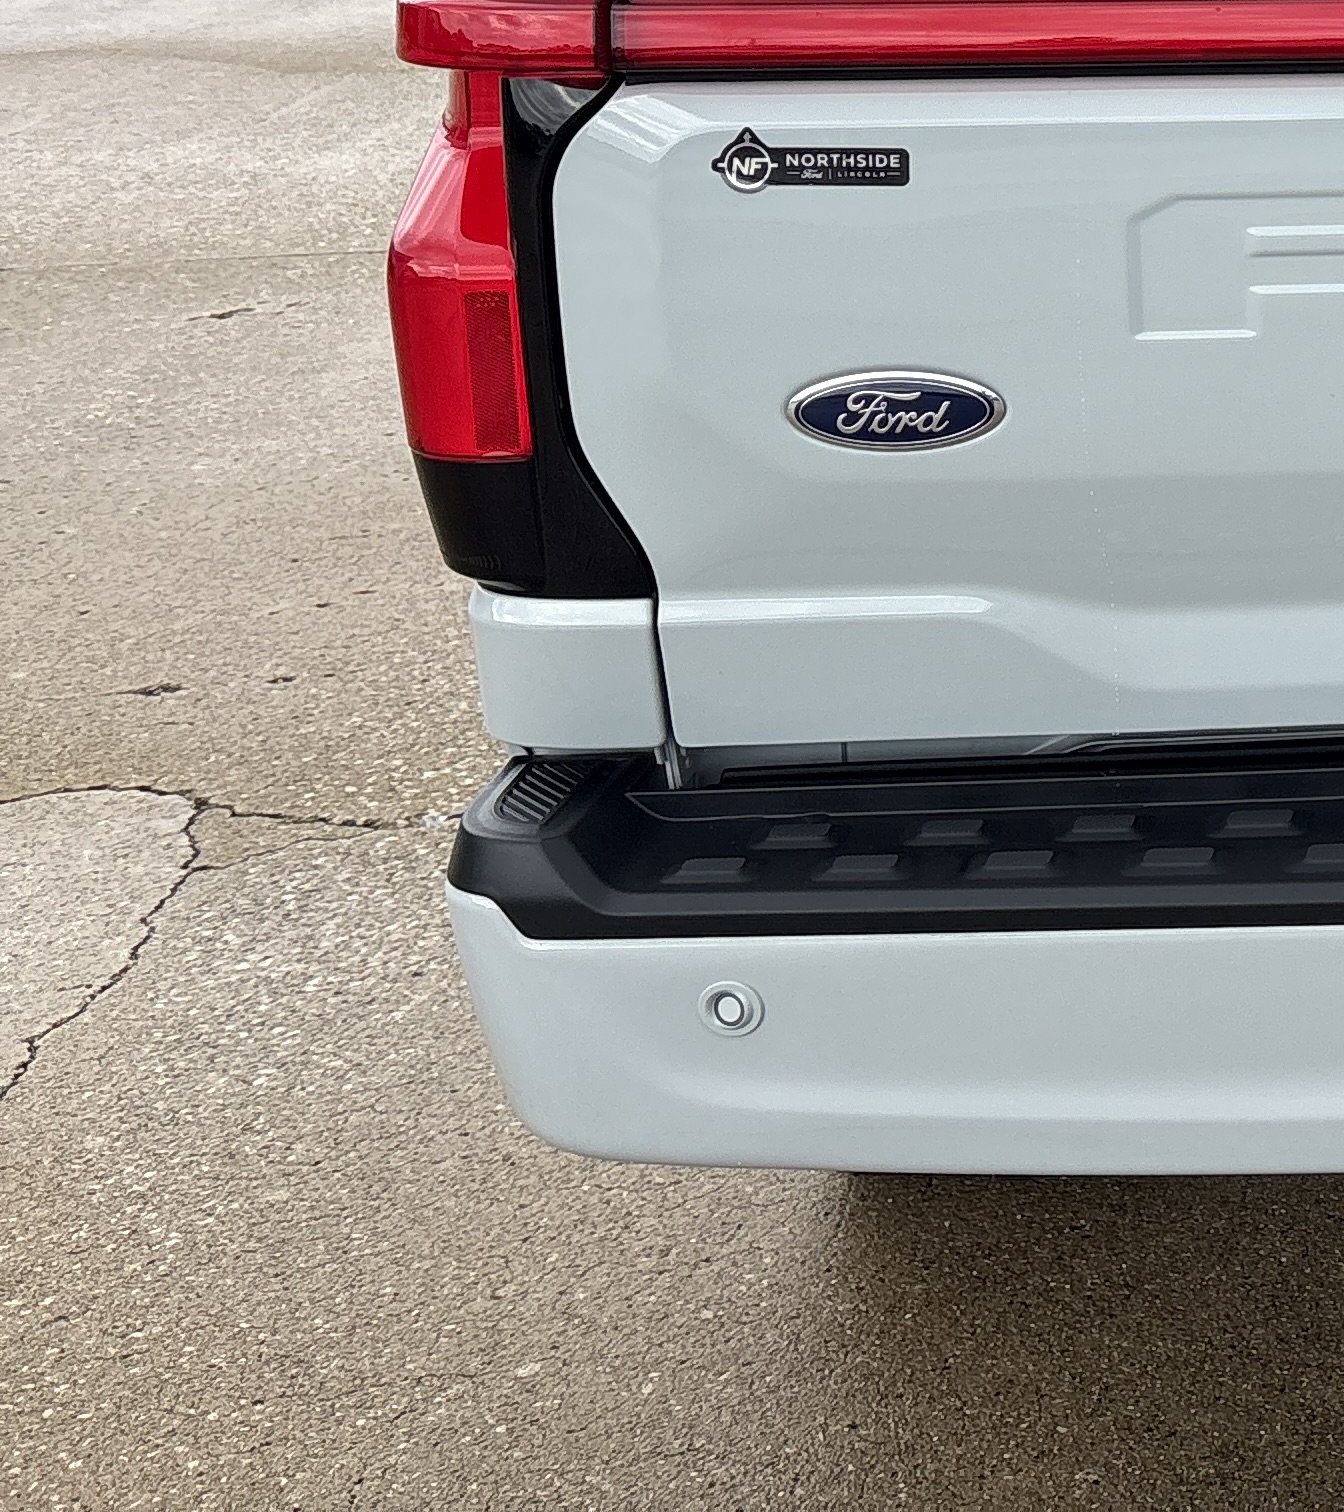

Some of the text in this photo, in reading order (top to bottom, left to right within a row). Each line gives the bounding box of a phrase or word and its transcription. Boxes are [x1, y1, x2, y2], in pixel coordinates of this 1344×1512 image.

[732, 156, 770, 182] NF
[785, 153, 901, 168] NORTHSIDE
[801, 169, 824, 179] Ford
[836, 390, 951, 434] Ford
